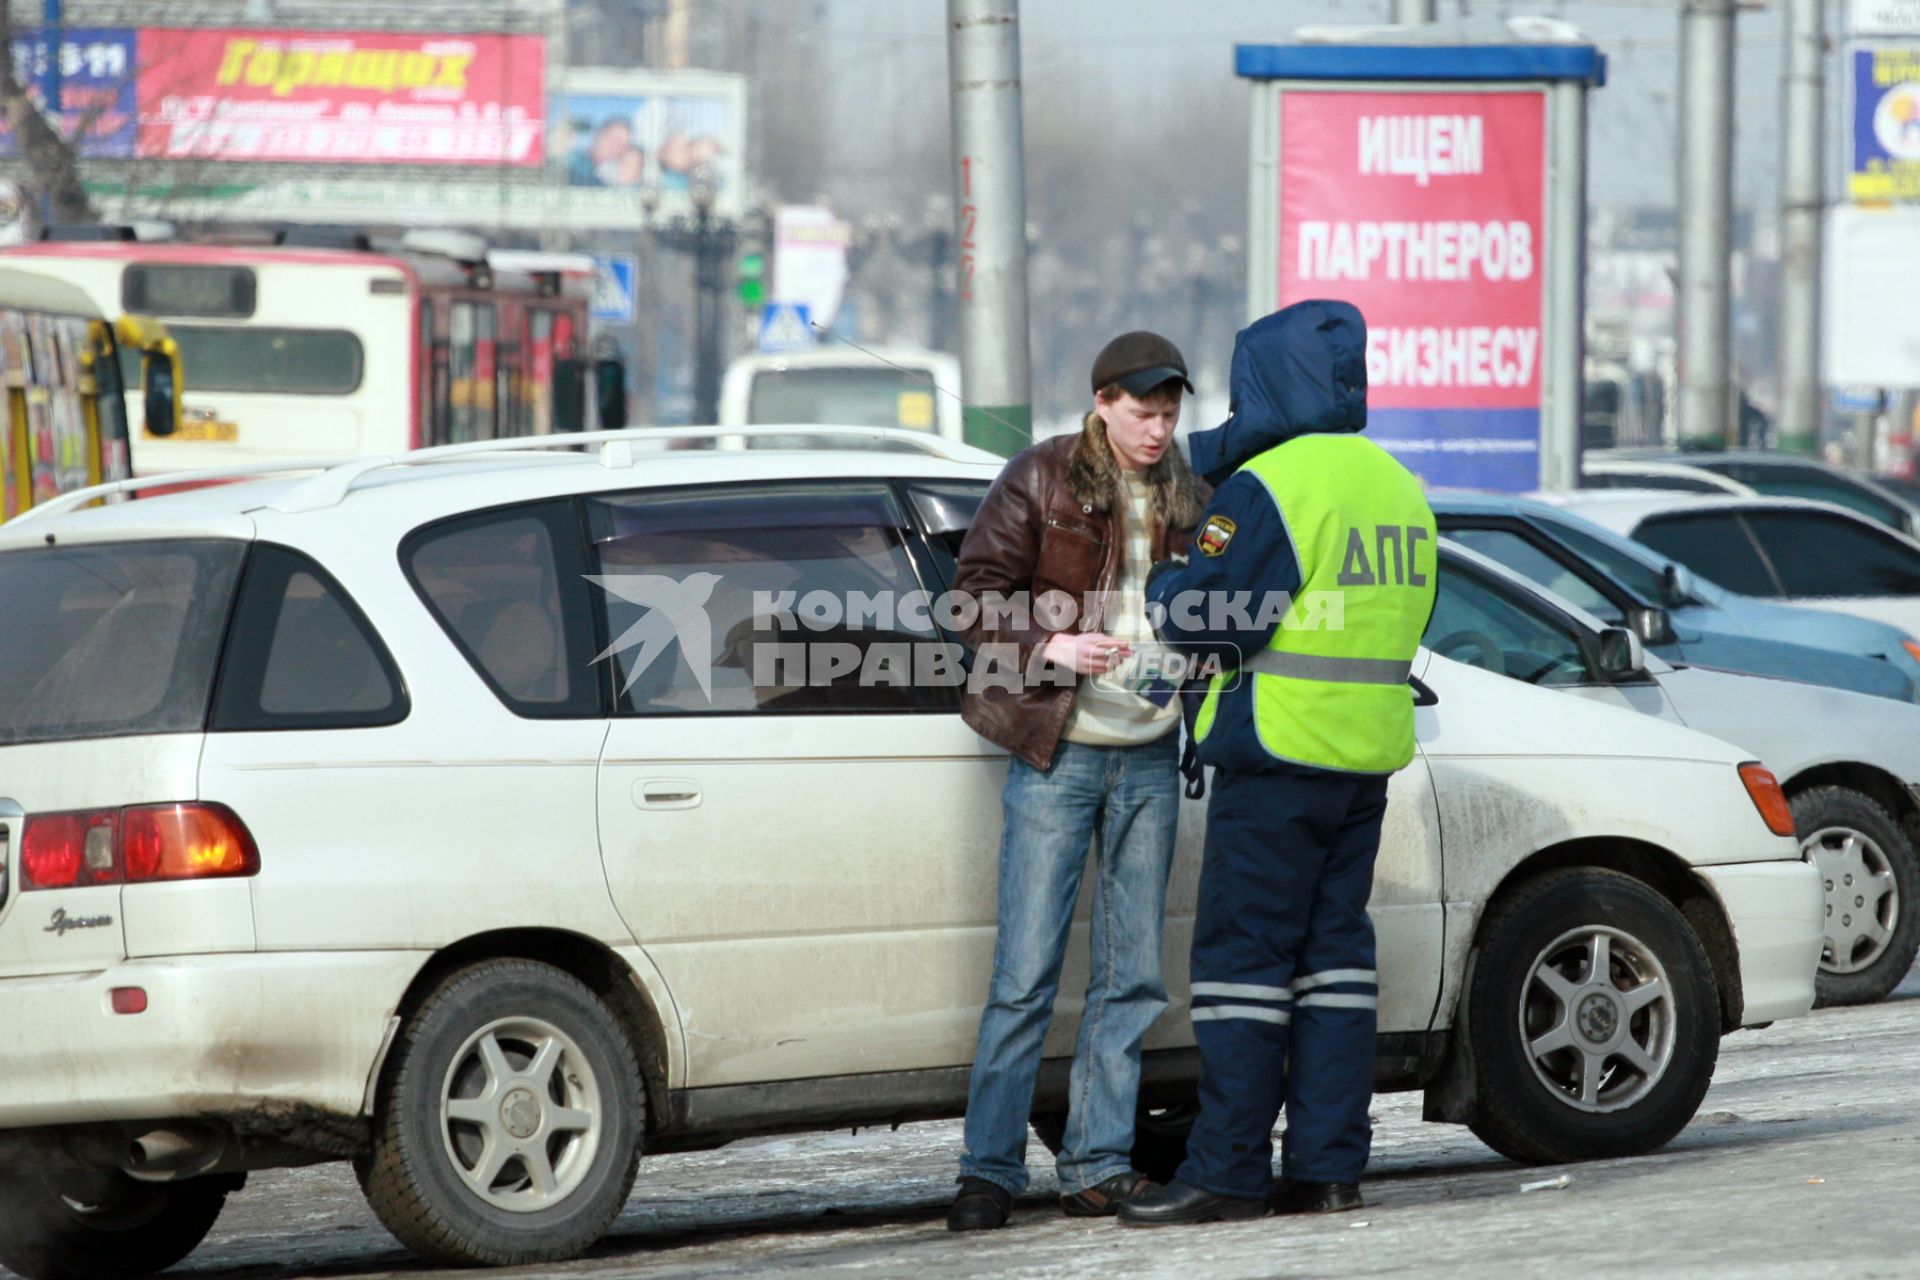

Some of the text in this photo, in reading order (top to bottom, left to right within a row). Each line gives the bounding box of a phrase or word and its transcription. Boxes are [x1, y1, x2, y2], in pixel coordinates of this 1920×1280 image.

[1358, 115, 1484, 187] ИЩЕМ
[1299, 220, 1534, 281] ПАРТНЕРОВ
[1367, 326, 1539, 389] БИЗНЕСУ
[1337, 524, 1429, 587] ДПС
